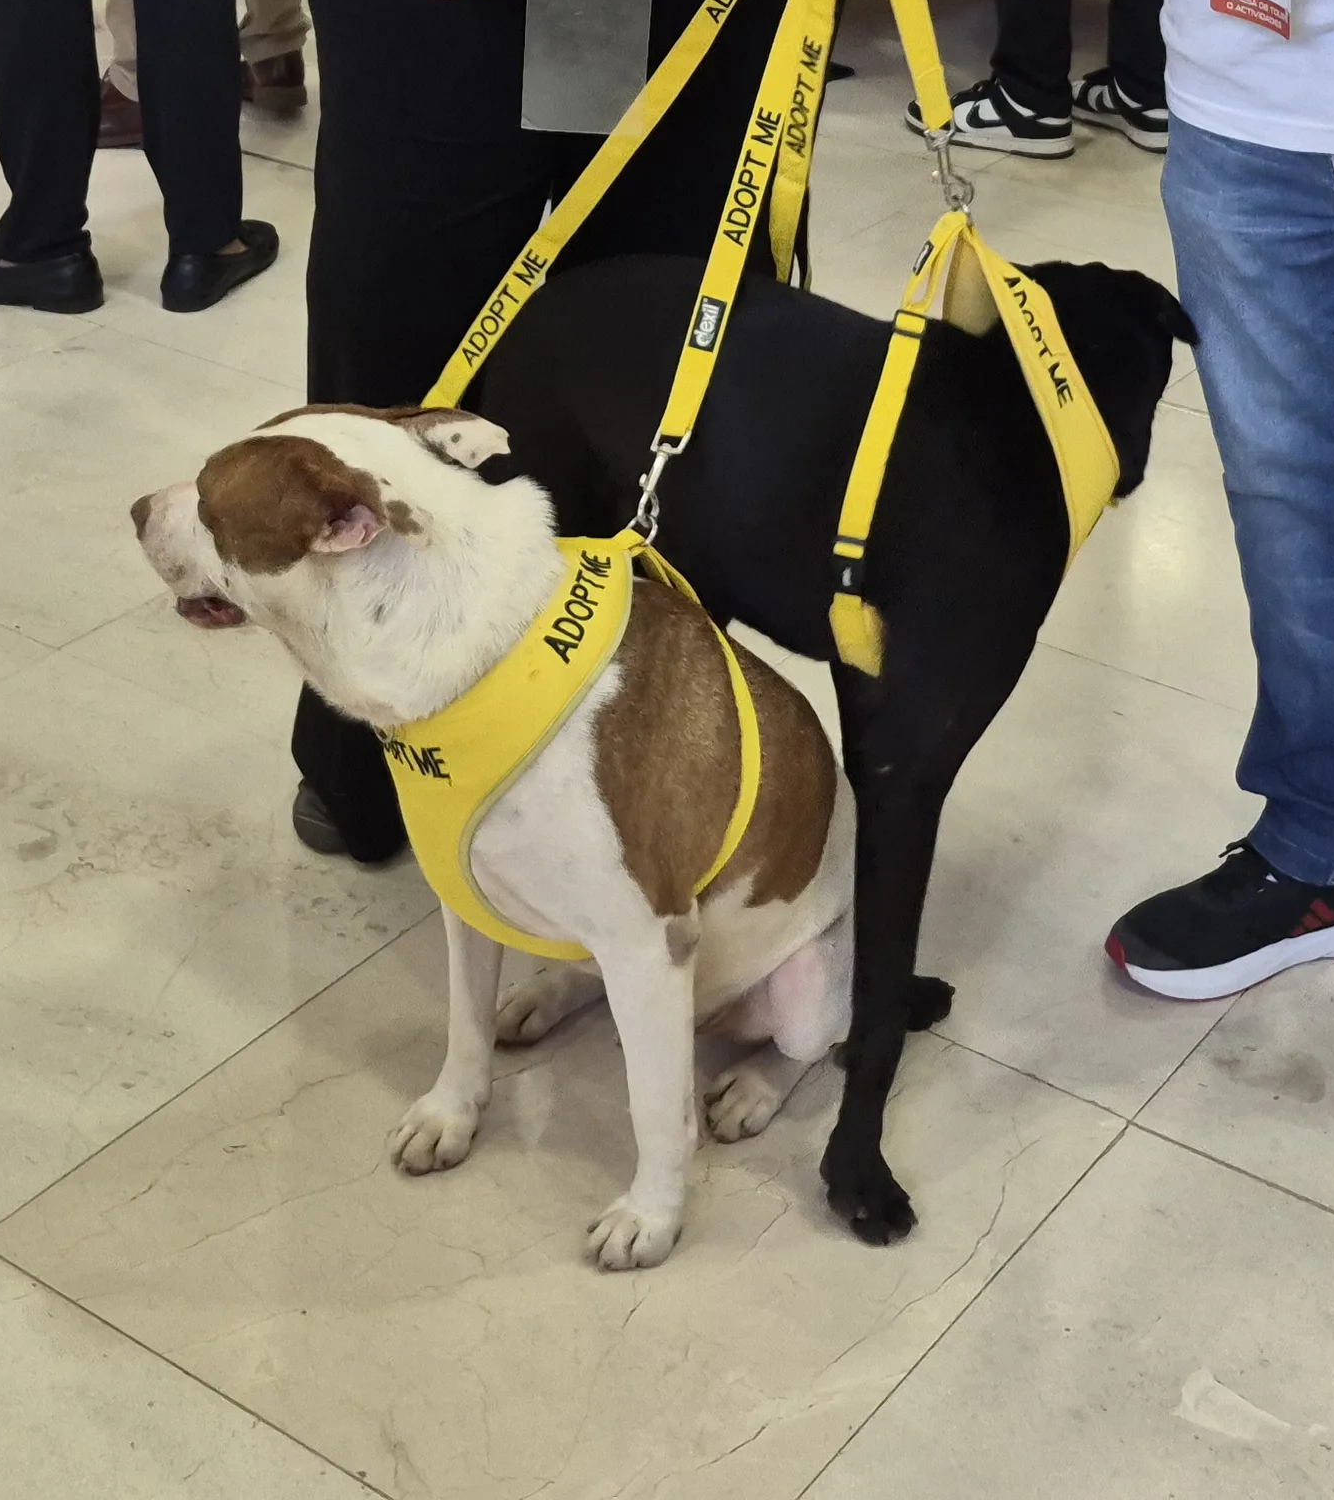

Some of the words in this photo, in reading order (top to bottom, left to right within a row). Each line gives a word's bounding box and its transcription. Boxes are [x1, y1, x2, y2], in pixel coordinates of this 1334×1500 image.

[800, 35, 823, 75] ME
[785, 73, 816, 159] ADOPT
[722, 149, 767, 247] ADOPT
[750, 106, 782, 147] ME
[461, 283, 520, 367] ADOPT
[512, 248, 548, 288] ME
[693, 299, 720, 348] dexil
[1048, 362, 1074, 409] ME
[543, 570, 606, 665] ADOPT
[579, 550, 612, 578] ME
[408, 745, 449, 778] ME
